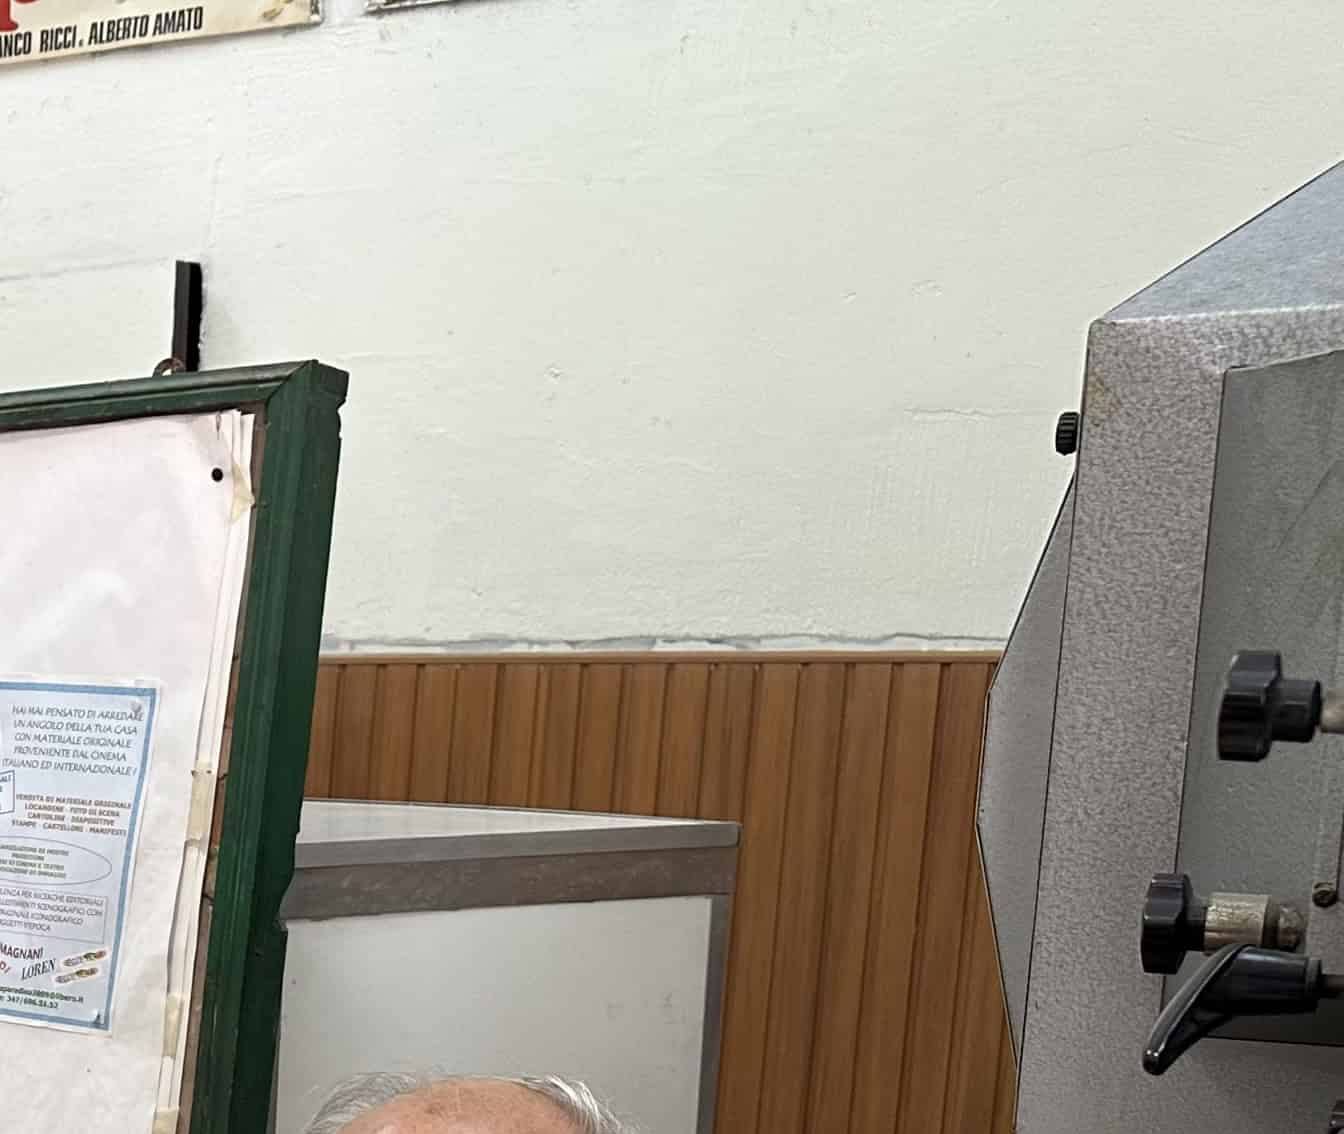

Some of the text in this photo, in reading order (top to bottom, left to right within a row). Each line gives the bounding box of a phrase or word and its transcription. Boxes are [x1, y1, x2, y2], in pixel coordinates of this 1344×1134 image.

[40, 25, 77, 53] RICCI
[88, 14, 148, 46] ALBERTO
[152, 6, 204, 38] AMATO
[21, 957, 57, 981] LOREN
